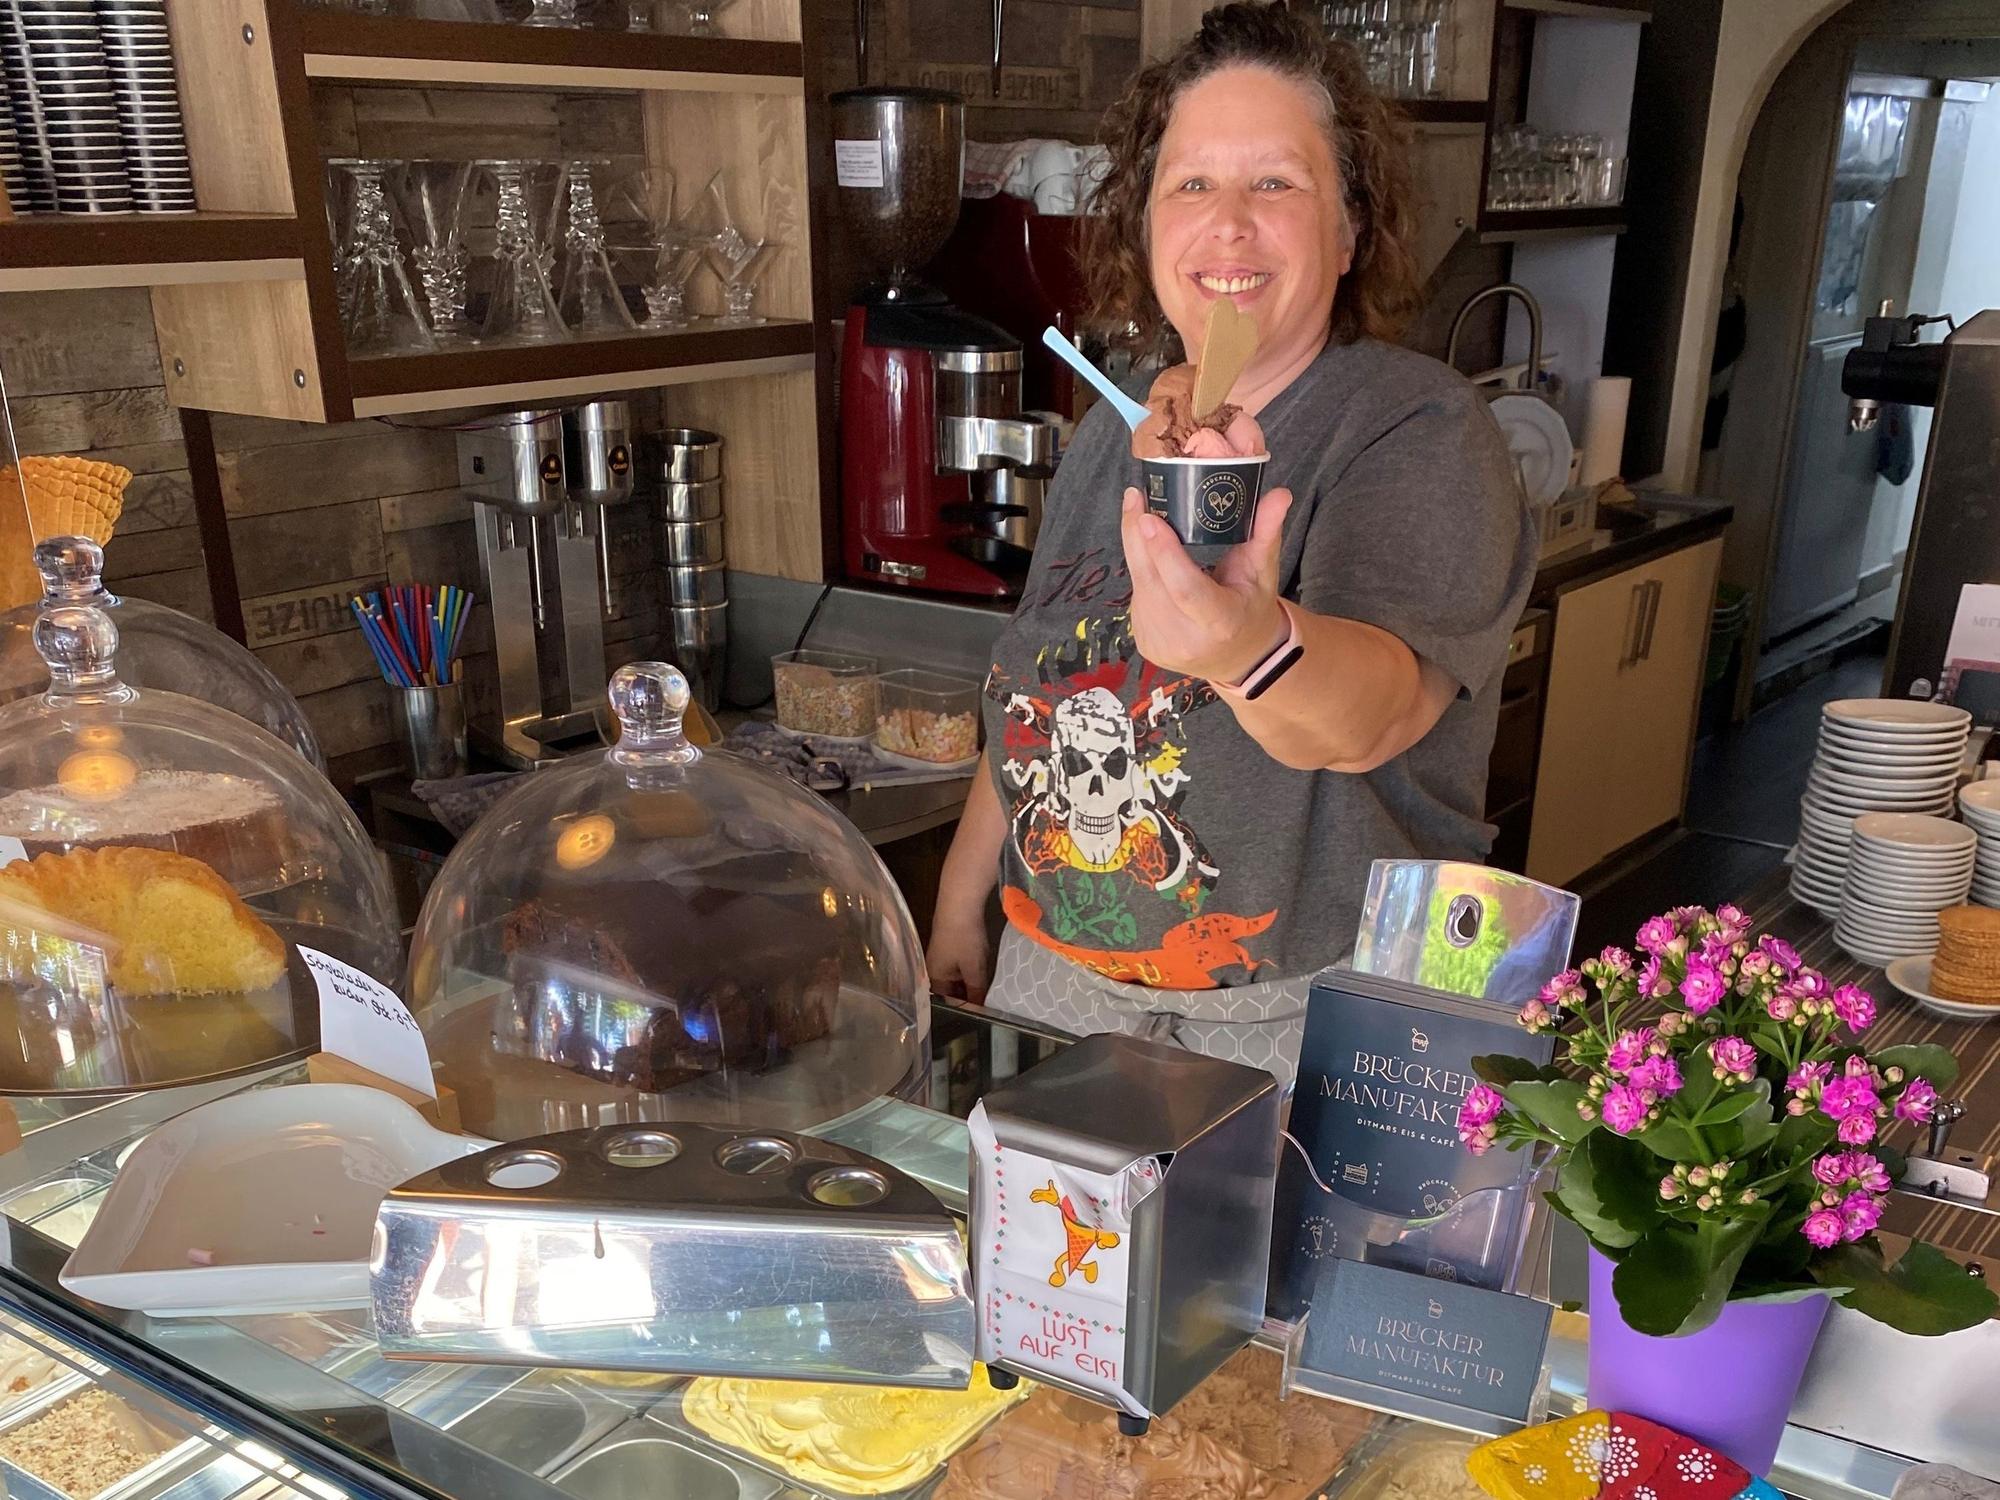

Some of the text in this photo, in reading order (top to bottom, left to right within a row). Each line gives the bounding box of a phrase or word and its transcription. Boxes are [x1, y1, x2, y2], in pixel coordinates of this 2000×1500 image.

[1353, 1050, 1477, 1098] BRÜCKER
[1319, 1074, 1464, 1129] MANUFAKT
[1357, 1117, 1456, 1148] DITMARS EIS & CAFÉ
[1042, 1317, 1092, 1349] LUST
[1376, 1316, 1484, 1357] BRÜCKER
[1020, 1334, 1117, 1381] AUF EIS!
[1346, 1335, 1504, 1388] MANUFAKTUR
